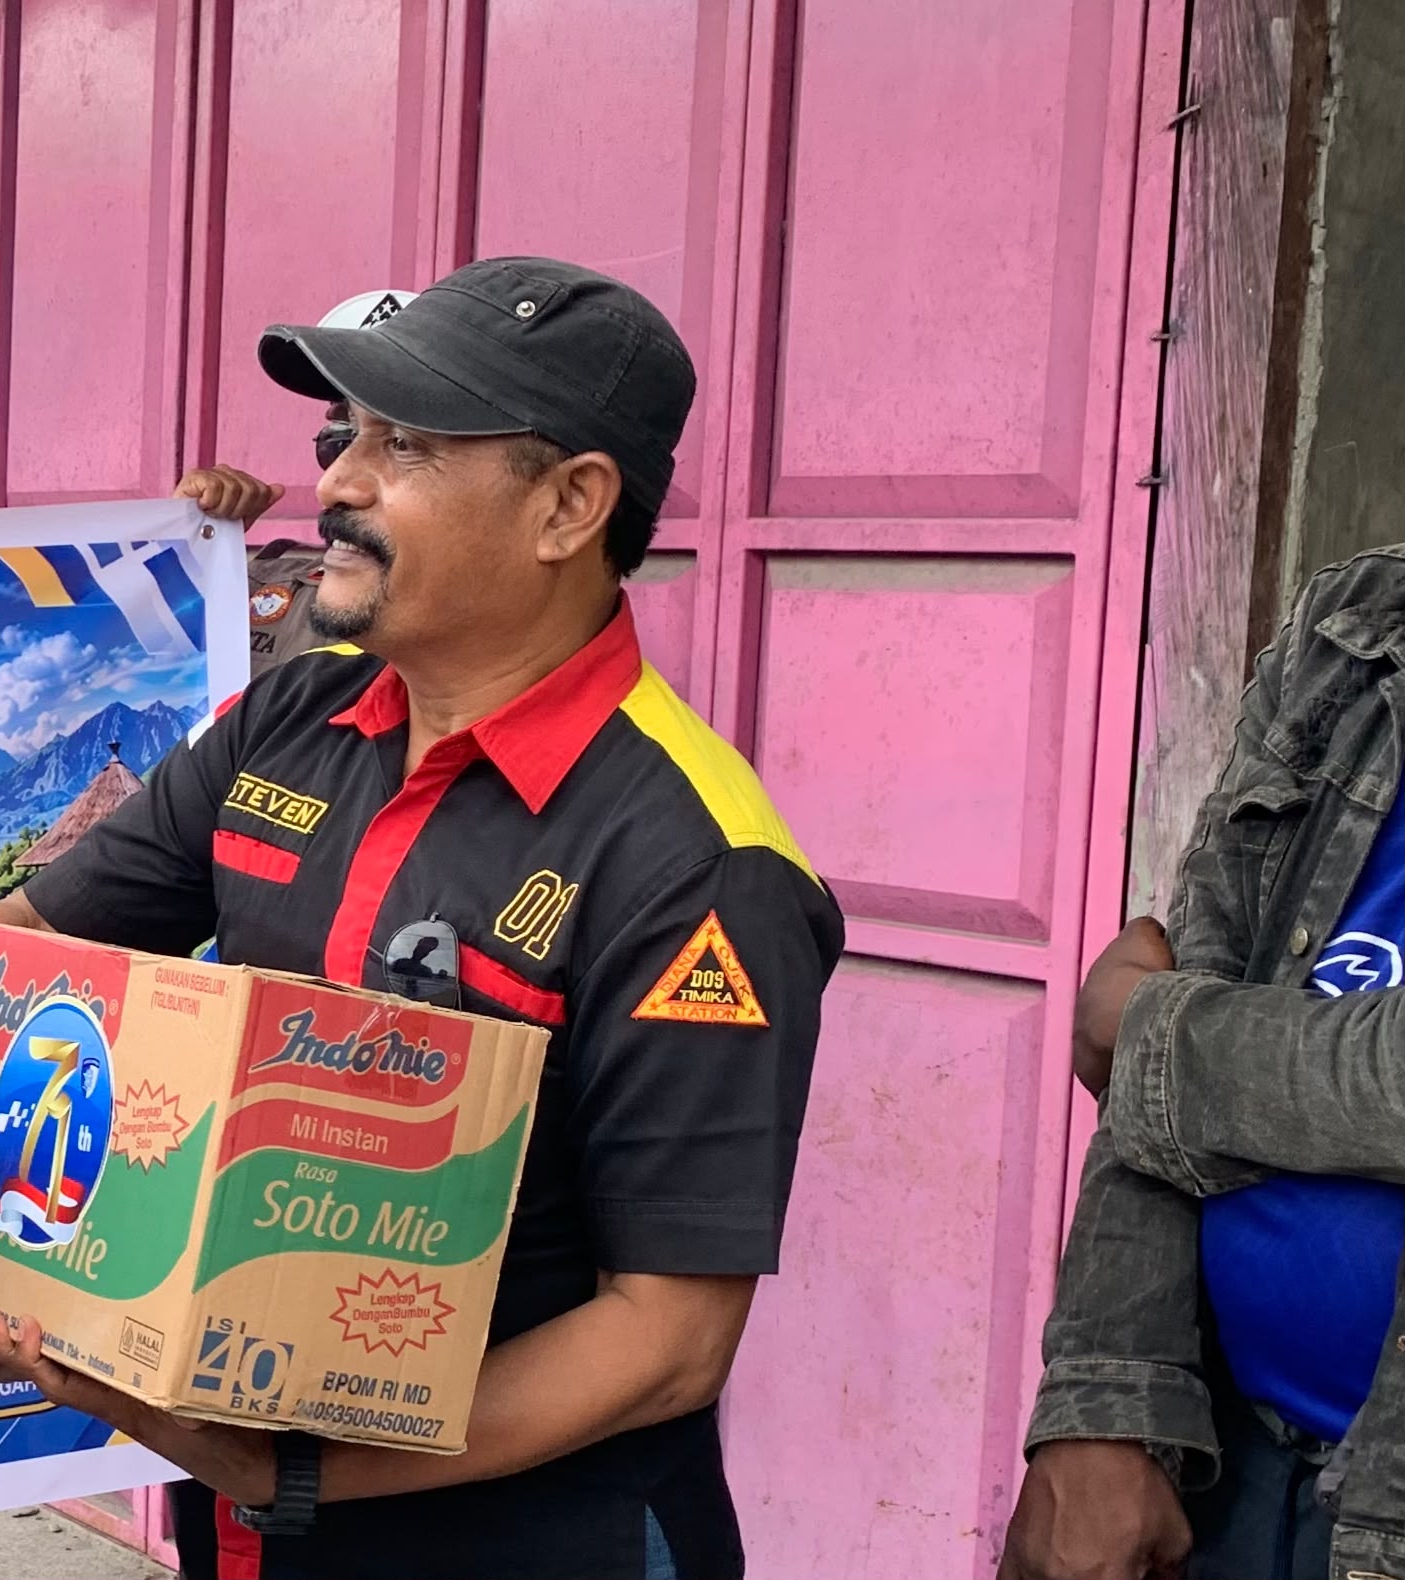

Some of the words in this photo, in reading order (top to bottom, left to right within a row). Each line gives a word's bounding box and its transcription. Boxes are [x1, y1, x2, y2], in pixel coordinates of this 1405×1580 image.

[494, 870, 579, 960] 01
[690, 970, 724, 989] DOS
[679, 990, 734, 1004] TIMIKA
[669, 1006, 737, 1020] STATION
[290, 1113, 318, 1140] Mi
[322, 1120, 389, 1154] Instan
[294, 1162, 338, 1183] Rasa
[253, 1180, 360, 1241] Soto
[367, 1201, 449, 1257] Mie
[370, 1293, 416, 1306] Lengkap
[206, 1316, 246, 1335] ISI
[378, 1322, 403, 1334] Soto
[136, 1331, 160, 1353] HALAL
[192, 1330, 294, 1400] 40
[322, 1371, 378, 1398] BPOM
[379, 1380, 399, 1401] RI
[402, 1383, 432, 1406] MD
[230, 1396, 279, 1415] BKS
